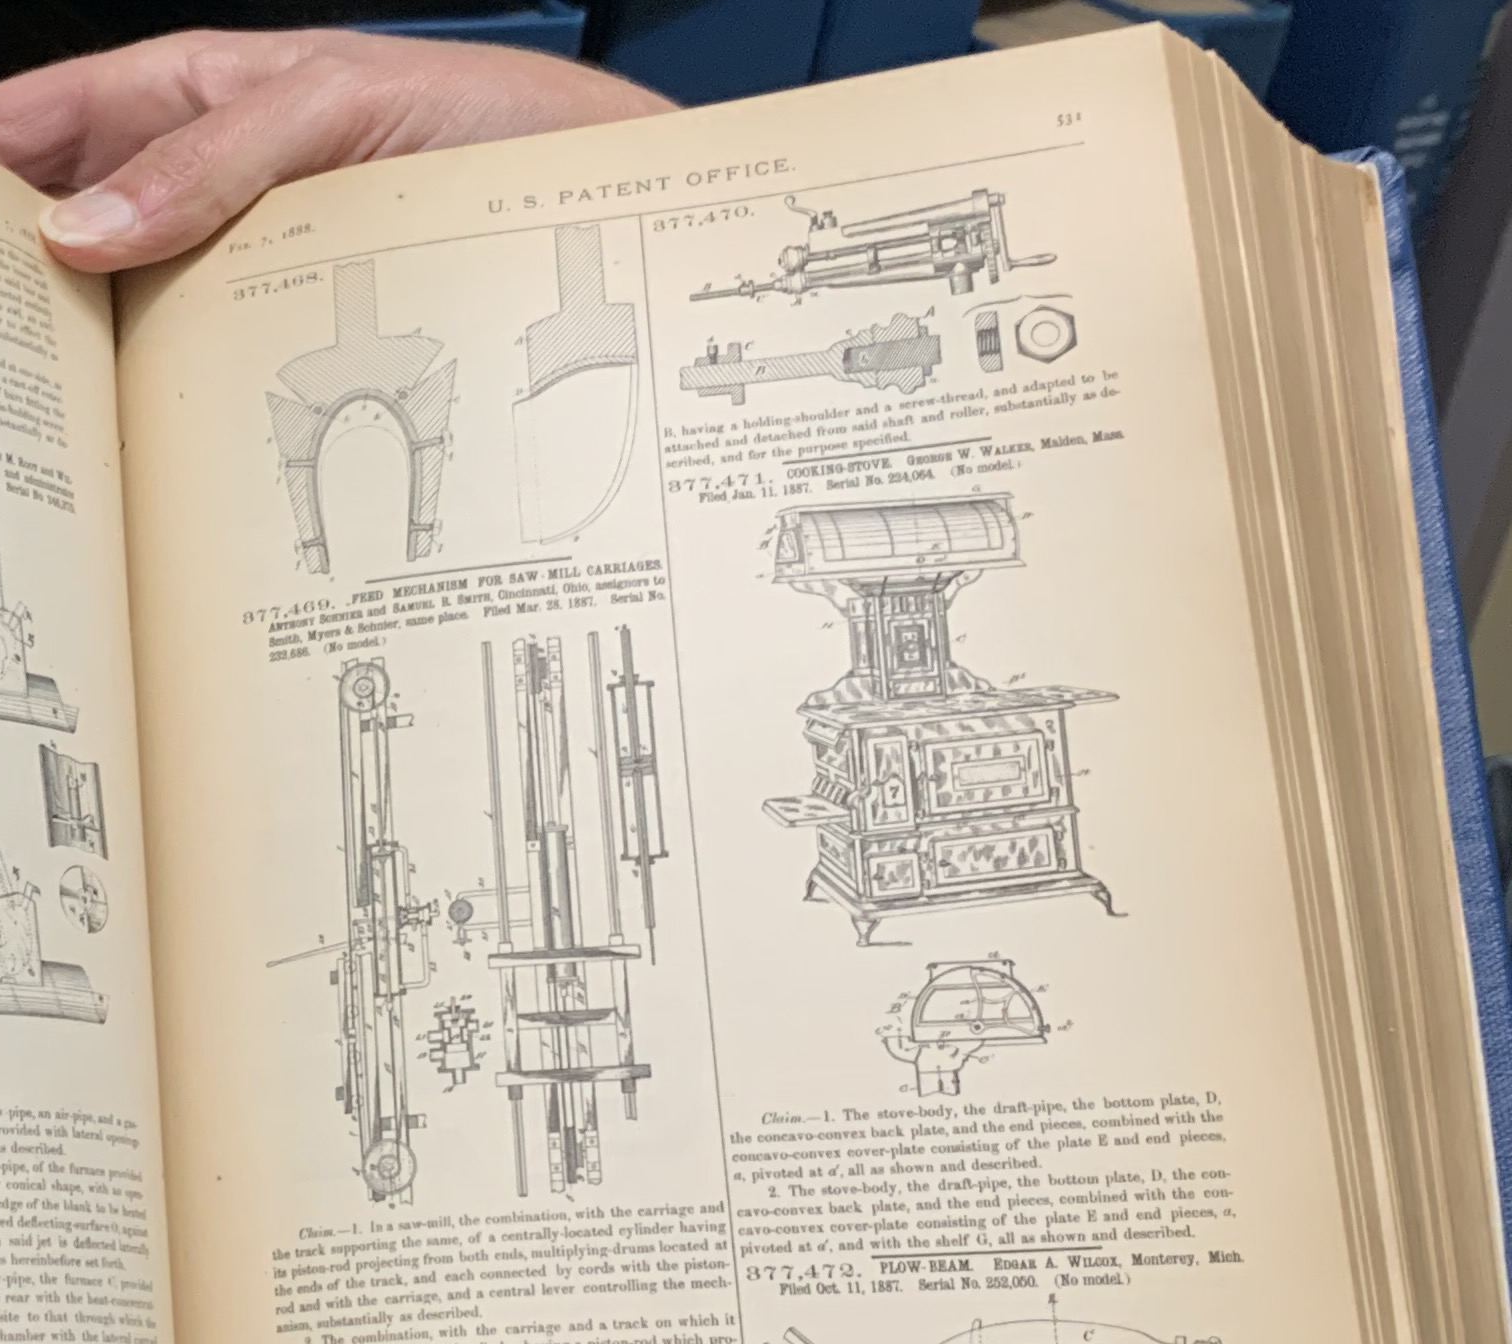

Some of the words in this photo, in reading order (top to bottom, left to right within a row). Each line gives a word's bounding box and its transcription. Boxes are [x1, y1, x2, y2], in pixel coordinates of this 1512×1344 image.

[559, 175, 671, 206] PATENT
[686, 157, 796, 188] OFFICE.
[392, 578, 468, 598] MECHANISM
[1131, 1253, 1199, 1267] Monterey,
[779, 1283, 811, 1296] Filed
[816, 1282, 840, 1295] Oct.
[919, 1278, 955, 1291] Serial
[961, 1277, 981, 1290] No.
[1054, 1274, 1079, 1288] (No
